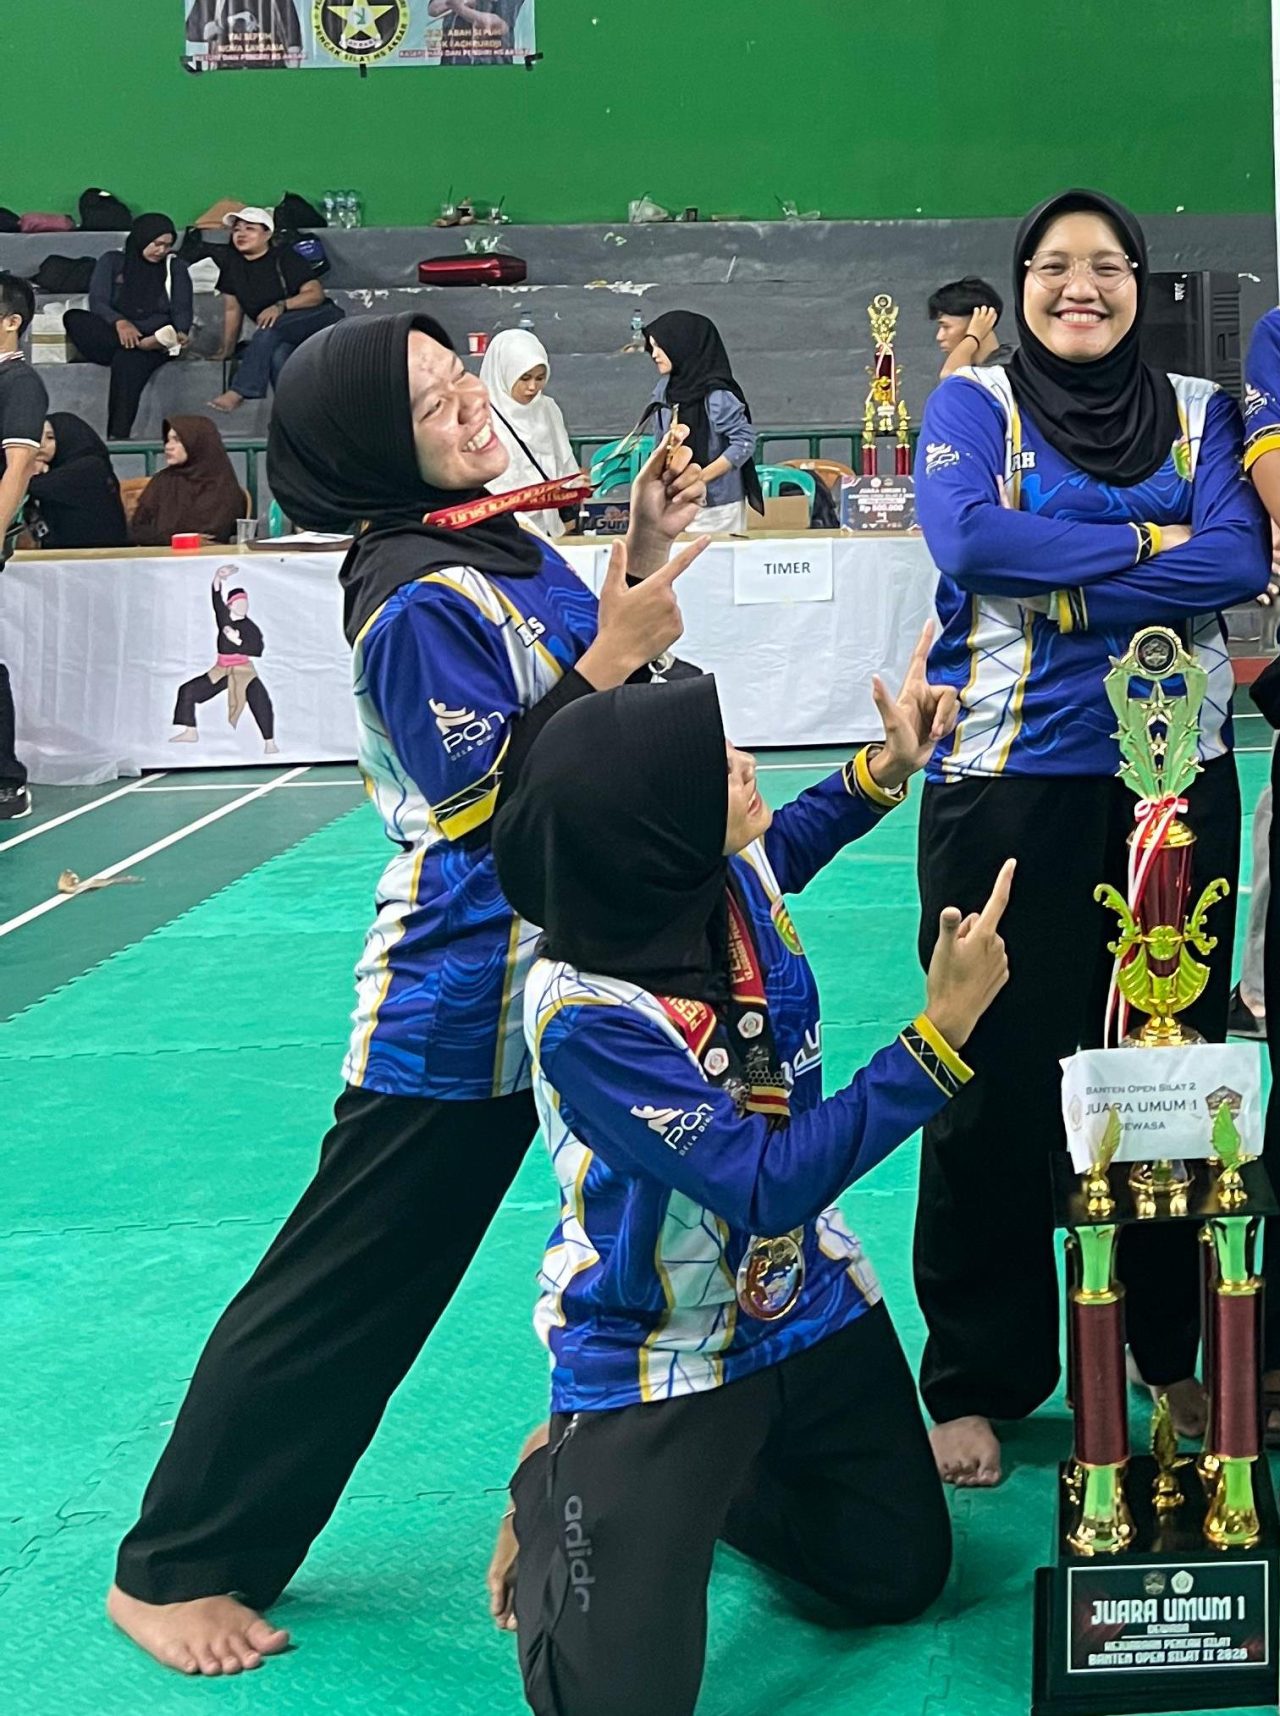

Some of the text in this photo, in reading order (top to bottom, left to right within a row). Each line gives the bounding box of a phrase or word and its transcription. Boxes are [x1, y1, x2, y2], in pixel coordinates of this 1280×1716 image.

[344, 54, 371, 62] SILAT
[763, 562, 811, 575] TIMER
[1086, 1083, 1196, 1095] BANTEN OPEN SILAT 2
[1086, 1099, 1198, 1115] JUARA UMUM 1
[1120, 1122, 1166, 1131] DEWASA
[1090, 1595, 1245, 1625] JUARA UMUM 1
[1203, 1637, 1231, 1648] SILAT
[1088, 1652, 1133, 1666] BANTEN
[1135, 1651, 1165, 1664] OPEN
[1167, 1649, 1200, 1663] SILAT
[1202, 1649, 1214, 1661] II
